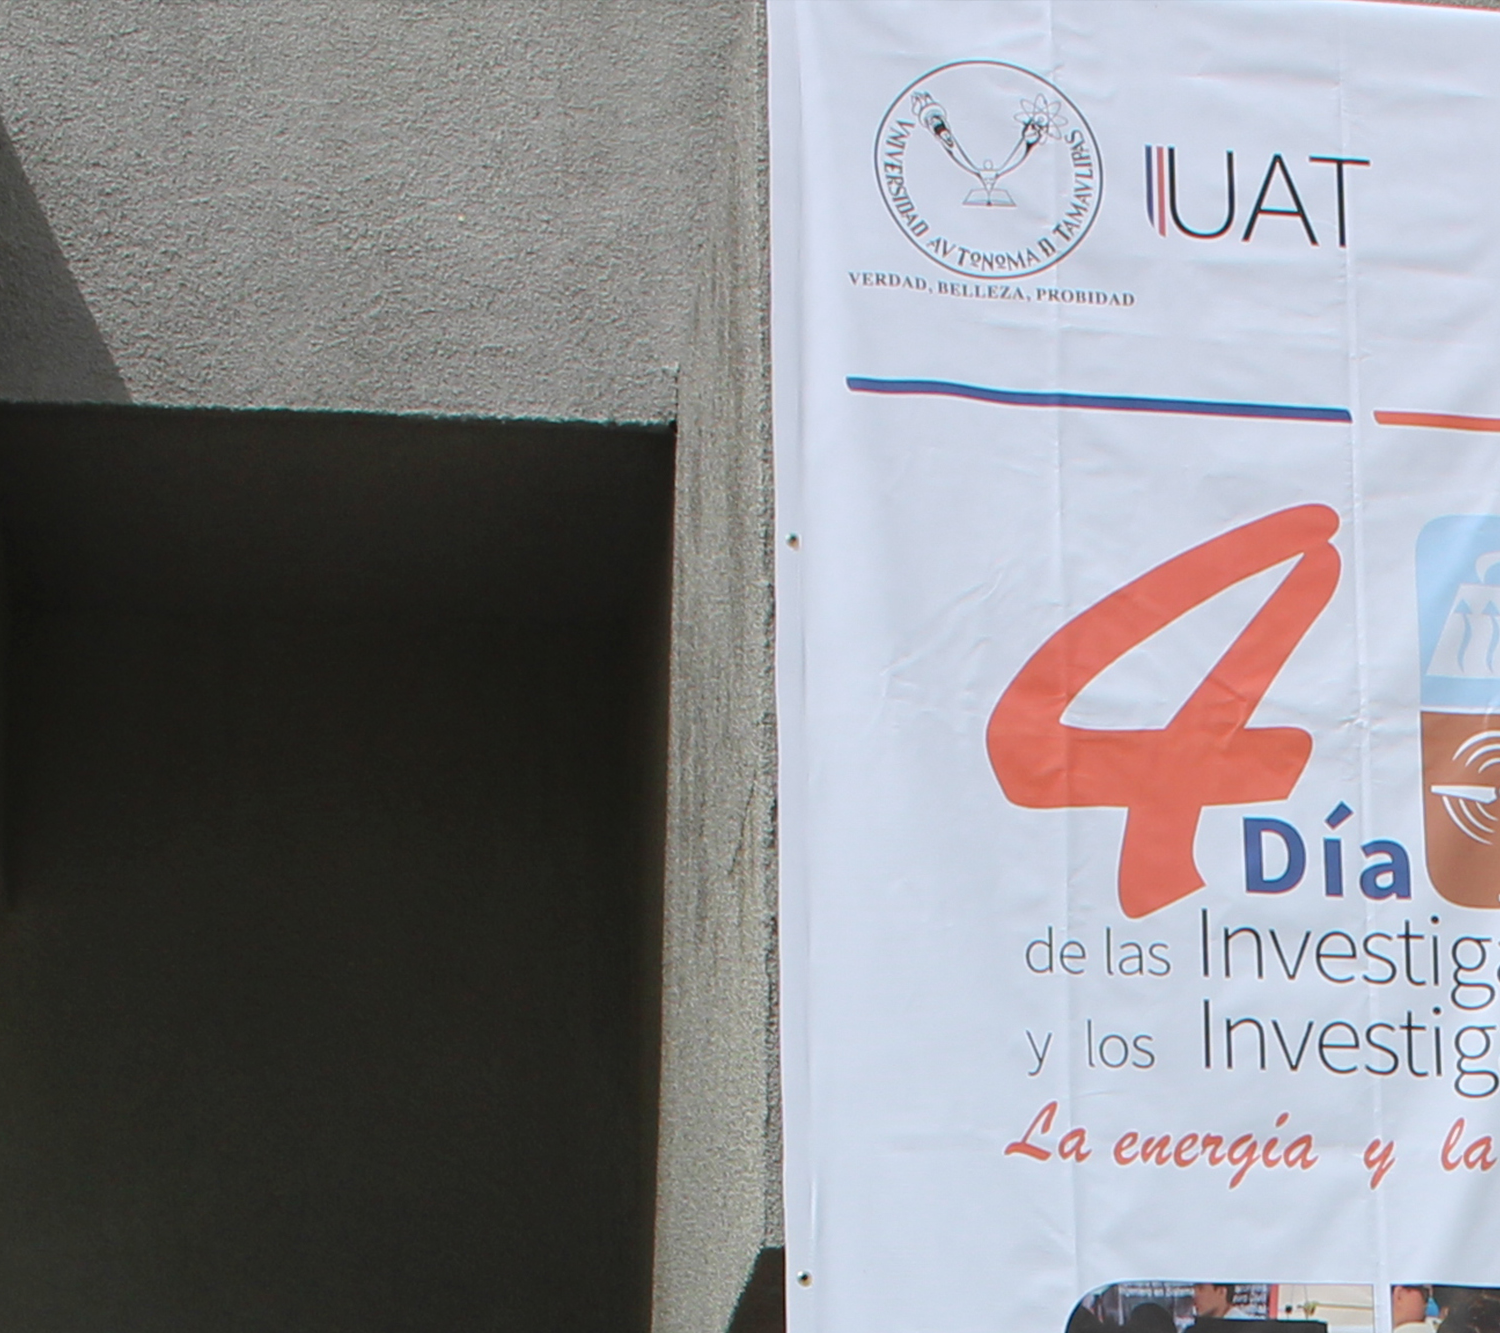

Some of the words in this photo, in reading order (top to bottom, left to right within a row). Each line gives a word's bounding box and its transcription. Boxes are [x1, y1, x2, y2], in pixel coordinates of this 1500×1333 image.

[848, 271, 933, 295] VERDAD,
[936, 281, 1031, 303] BELLEZA,
[1036, 287, 1136, 307] PROBIDAD
[984, 502, 1342, 919] 4
[1241, 800, 1413, 901] Día
[1024, 925, 1088, 976] de
[1106, 926, 1171, 978] las
[1025, 1028, 1054, 1077] y
[1087, 1018, 1156, 1070] los
[1004, 1099, 1093, 1164] La
[1111, 1111, 1321, 1189] energía
[1362, 1135, 1398, 1188] y
[1439, 1116, 1497, 1174] la
